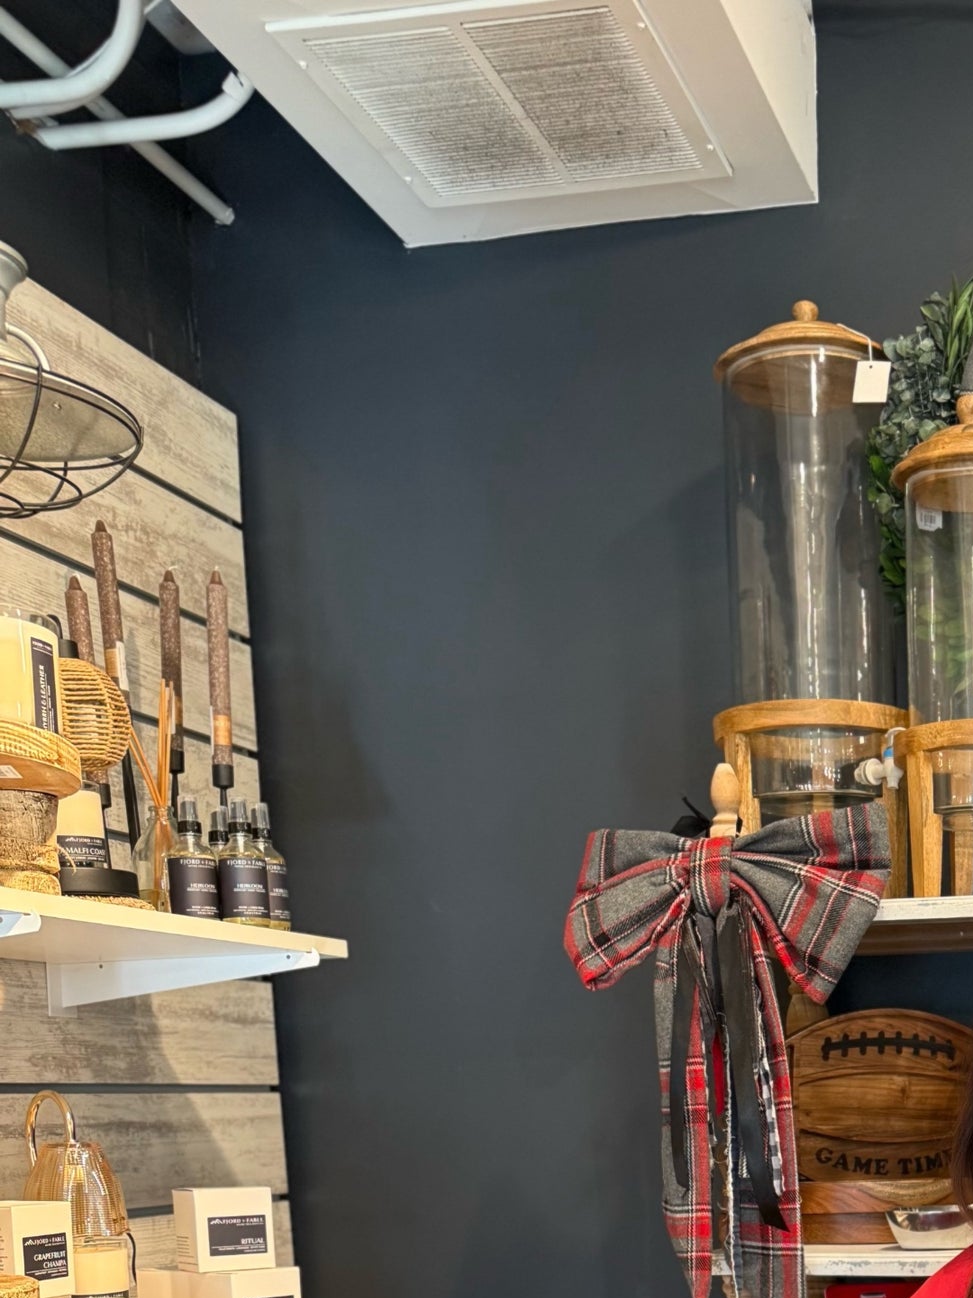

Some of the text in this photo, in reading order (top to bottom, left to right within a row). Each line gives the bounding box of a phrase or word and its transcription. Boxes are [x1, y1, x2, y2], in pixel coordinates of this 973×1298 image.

[815, 1147, 889, 1176] GAME
[241, 1237, 264, 1245] RITUAL
[33, 1251, 66, 1261] GRAPEFRUIT
[43, 1260, 67, 1269] CHAMPA
